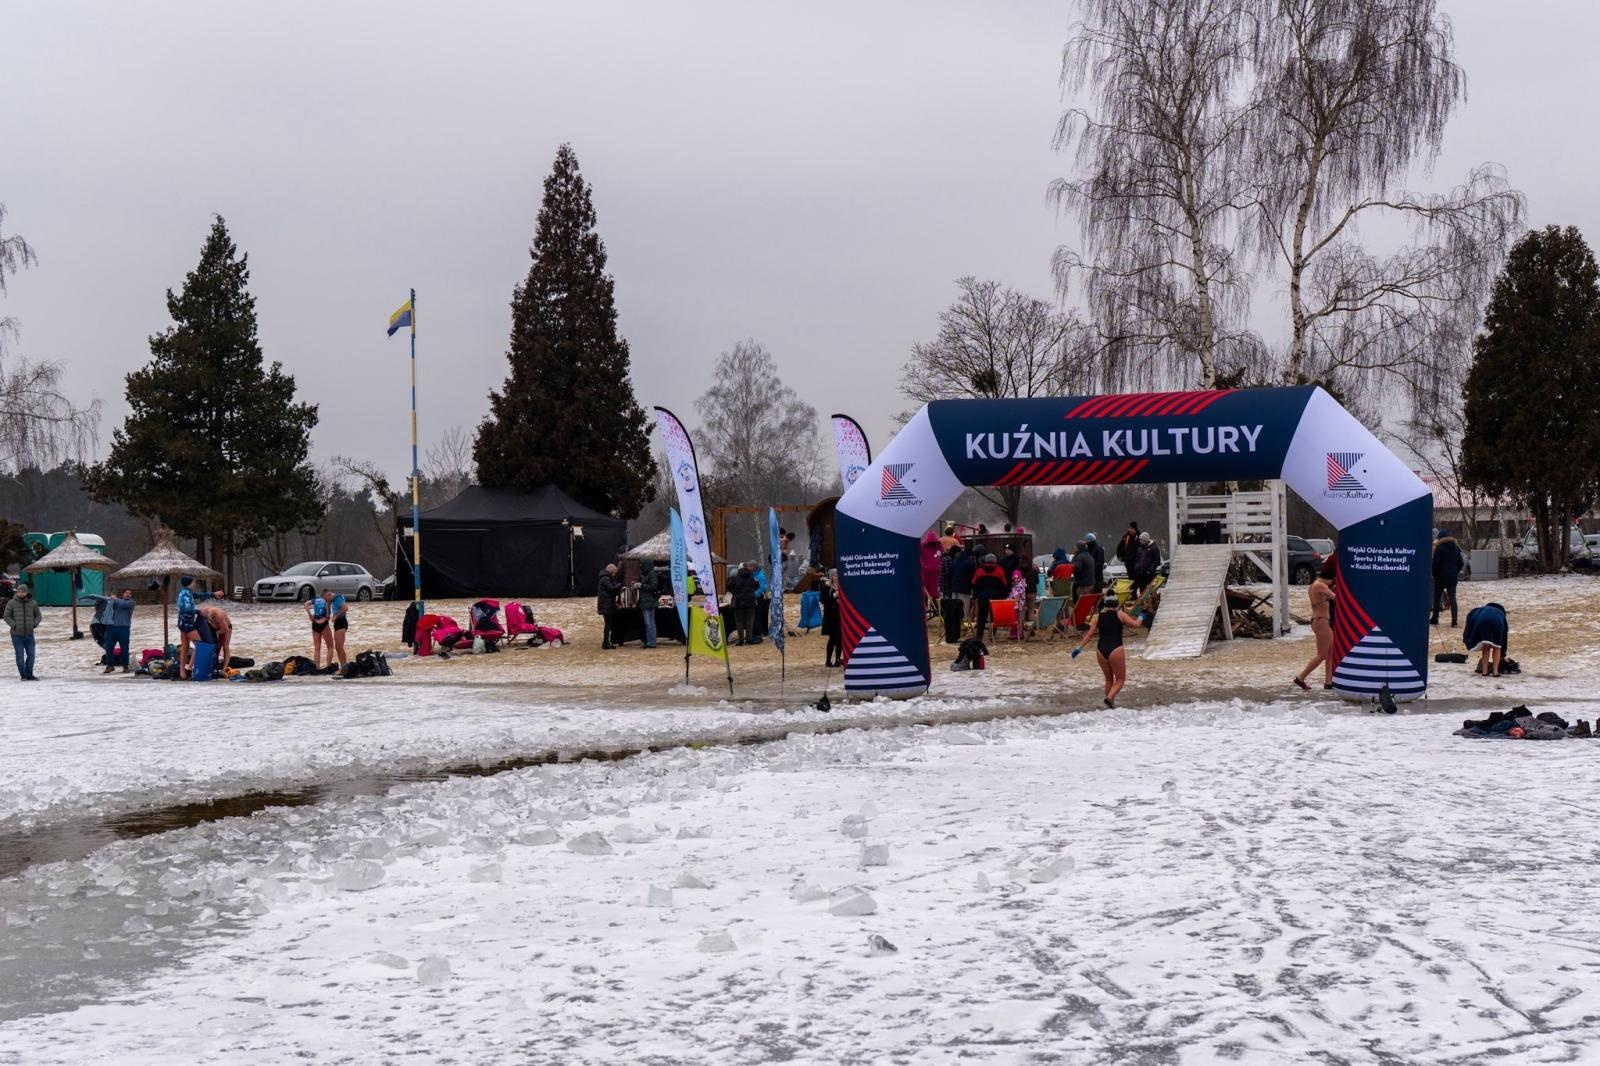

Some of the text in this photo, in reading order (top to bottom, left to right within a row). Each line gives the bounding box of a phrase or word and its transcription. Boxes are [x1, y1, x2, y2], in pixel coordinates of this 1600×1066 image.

[966, 424, 1263, 459] KUŹNIA KULTURY
[1395, 547, 1416, 555] Kultury
[878, 552, 899, 560] Kultury
[1372, 564, 1410, 572] Raciborskiej
